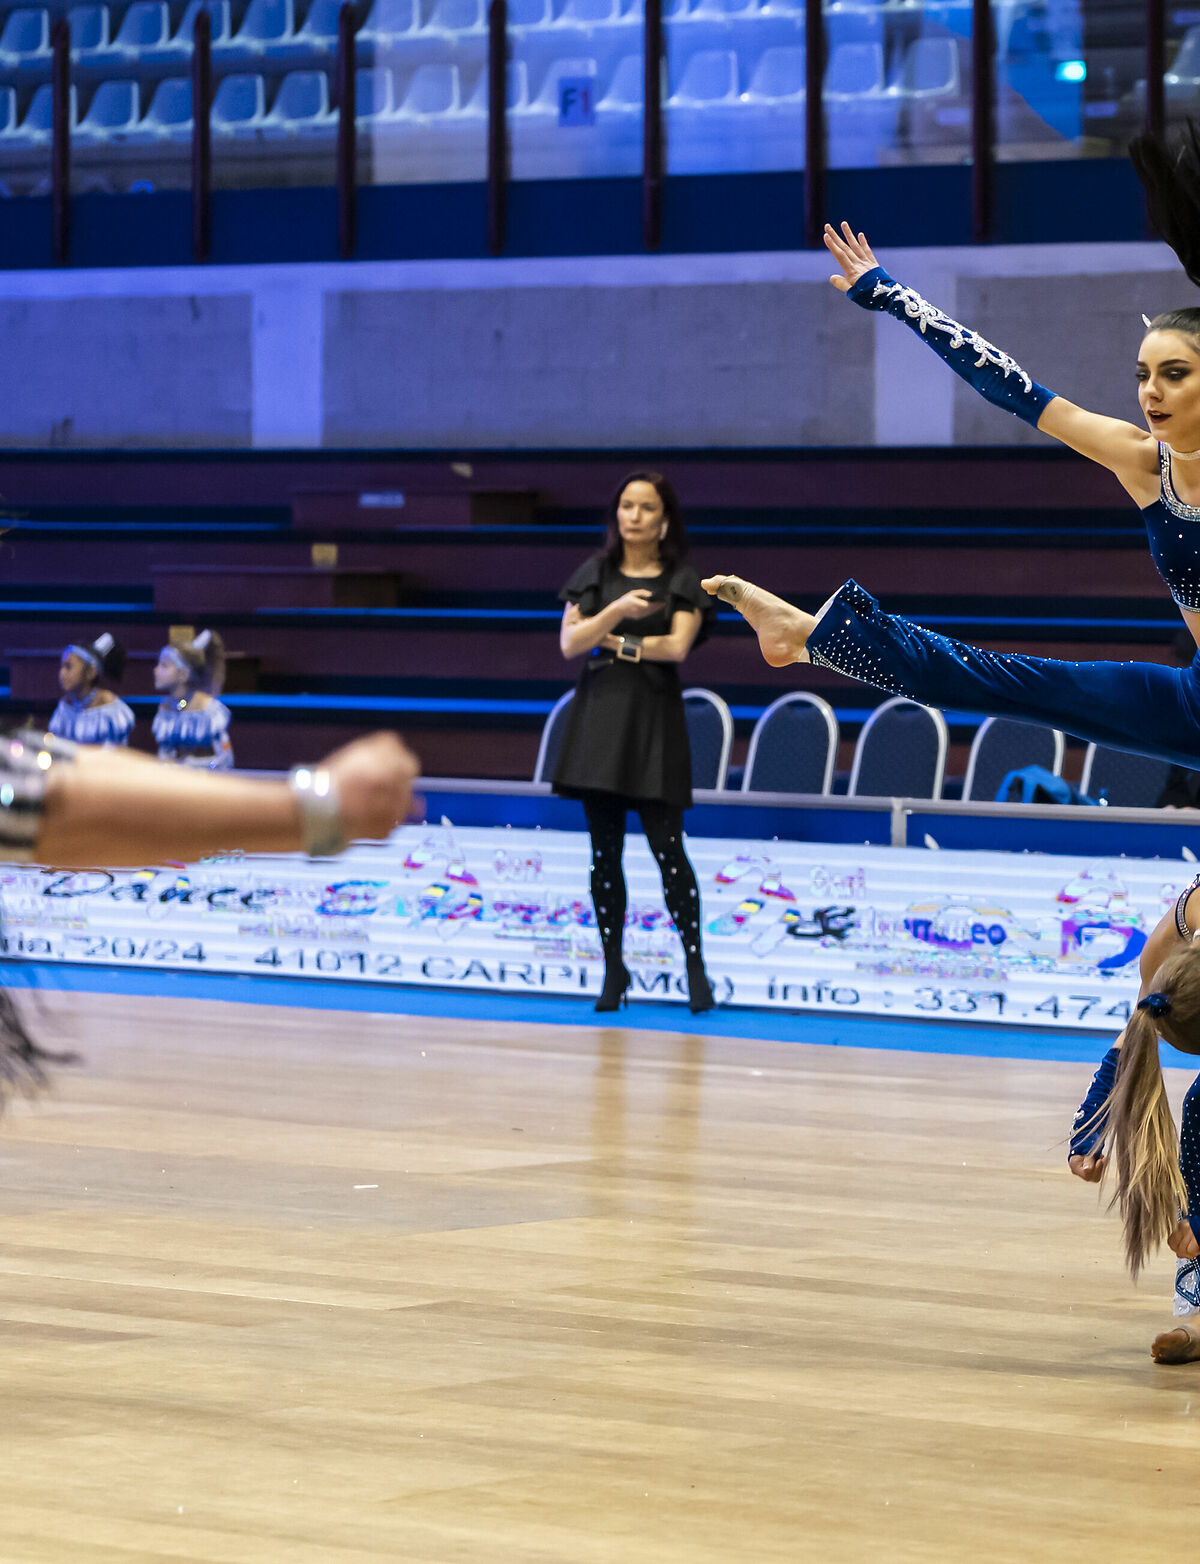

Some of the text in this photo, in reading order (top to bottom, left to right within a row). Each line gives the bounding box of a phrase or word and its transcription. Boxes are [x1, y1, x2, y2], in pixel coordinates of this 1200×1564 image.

[561, 87, 589, 116] F1
[82, 935, 207, 962] 20/24
[254, 946, 402, 976] 41012
[421, 955, 588, 989] CARPI
[768, 973, 861, 1006] info
